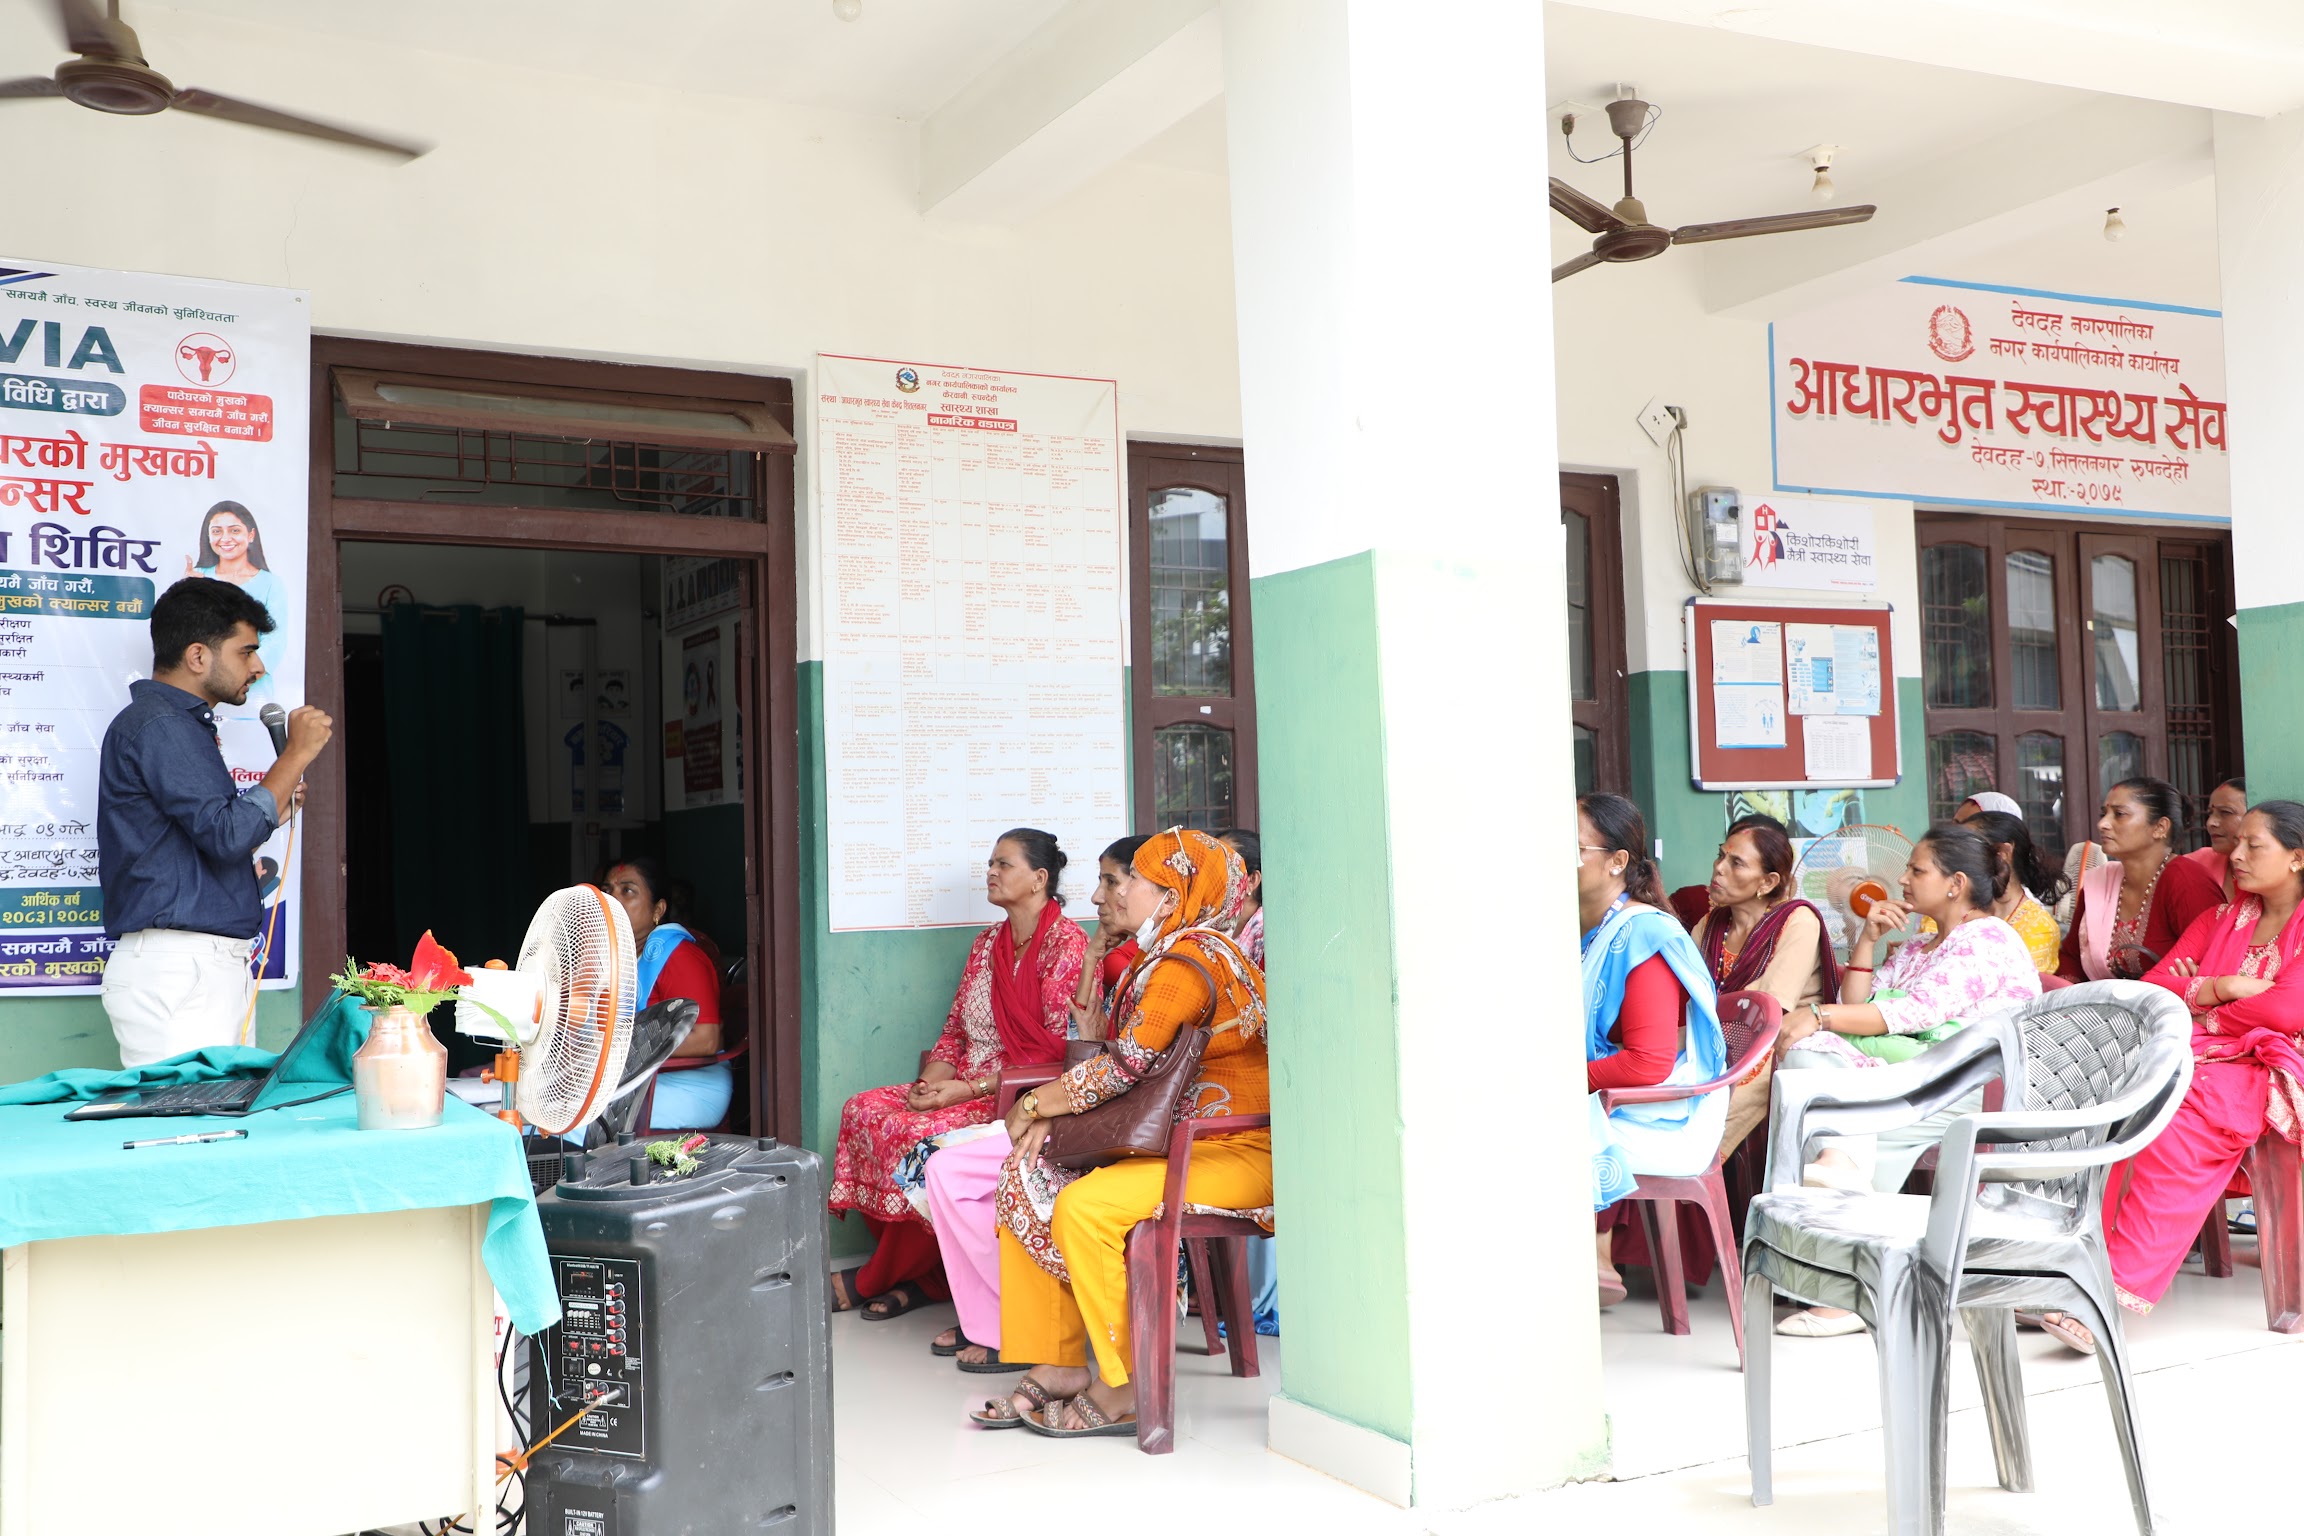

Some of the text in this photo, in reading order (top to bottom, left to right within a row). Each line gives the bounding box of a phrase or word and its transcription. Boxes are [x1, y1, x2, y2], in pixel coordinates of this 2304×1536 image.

[84, 297, 118, 310] स्वस्थ
[122, 301, 168, 315] जीवनको
[2011, 300, 2153, 344] देवदह नगरपालिका
[1990, 337, 2180, 380] नगर कार्यपालिकाको कार्यालय
[3, 378, 109, 411] विधि द्वारा
[167, 390, 247, 406] पाठेघरको मुखको
[1786, 356, 1996, 444] आधारभुत
[2003, 380, 2158, 445] स्वास्थ्य
[143, 403, 184, 416] क्यान्सर
[188, 407, 223, 419] समयमै
[226, 409, 246, 421] जाँच
[152, 418, 180, 429] जीवन
[183, 421, 220, 434] सुरक्षित
[929, 415, 1015, 430] नागरिक वडापत्र
[0, 429, 218, 482] रको मुखको
[29, 521, 161, 573] शिविर
[1786, 532, 1859, 551] किशोरकिशोरी
[1786, 547, 1872, 567] मैत्री स्वास्थ्य सेवा
[27, 574, 59, 591] जाँच
[48, 597, 110, 612] क्यान्सर
[115, 598, 143, 613] बचौं
[0, 647, 27, 659] कारी
[7, 721, 55, 733] जाँच सेवा
[59, 819, 91, 835] गते
[21, 890, 81, 907] आर्थिक वर्ष
[1, 936, 73, 956] समयमै
[45, 956, 106, 979] मुखको
[588, 1511, 605, 1519] BATTERY
